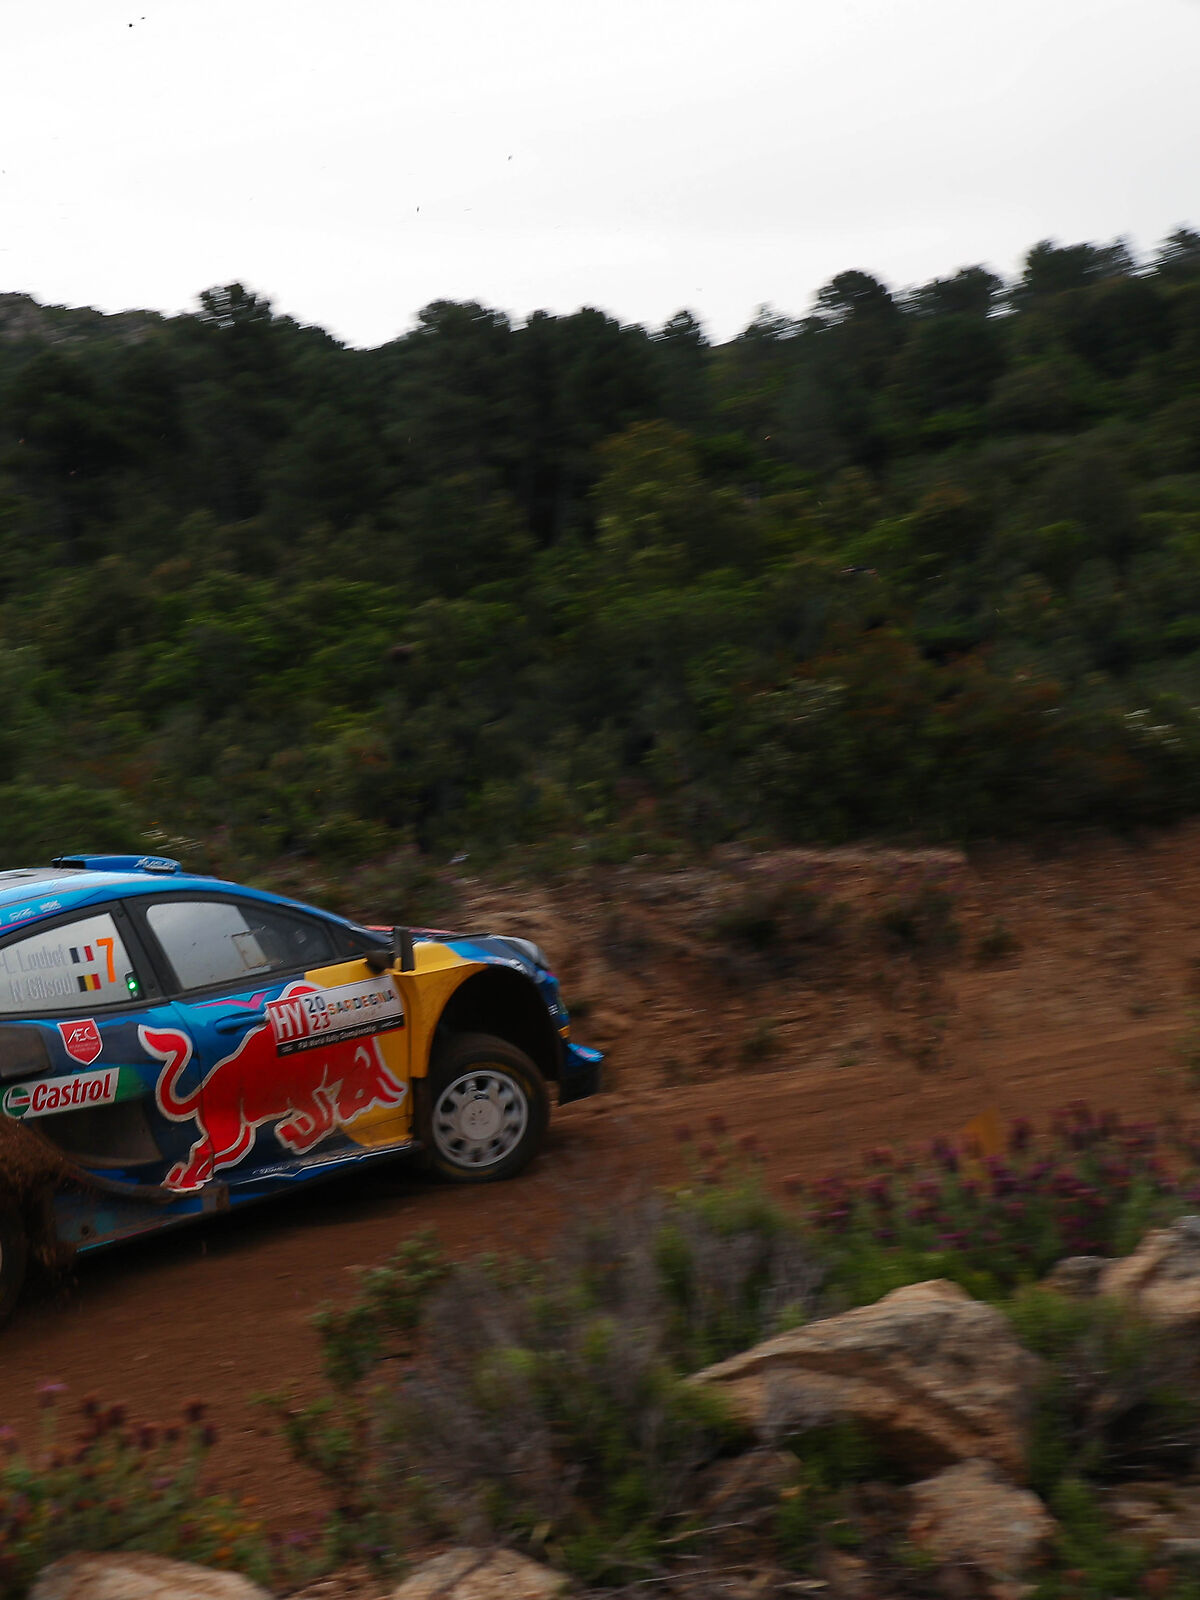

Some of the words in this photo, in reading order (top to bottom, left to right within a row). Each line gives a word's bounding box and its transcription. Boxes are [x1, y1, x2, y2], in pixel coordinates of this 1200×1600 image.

[17, 944, 68, 972] Loubet
[96, 937, 117, 983] 7
[271, 1001, 304, 1039] HY
[327, 989, 397, 1015] SARDEGNA
[31, 1073, 111, 1112] Castrol
